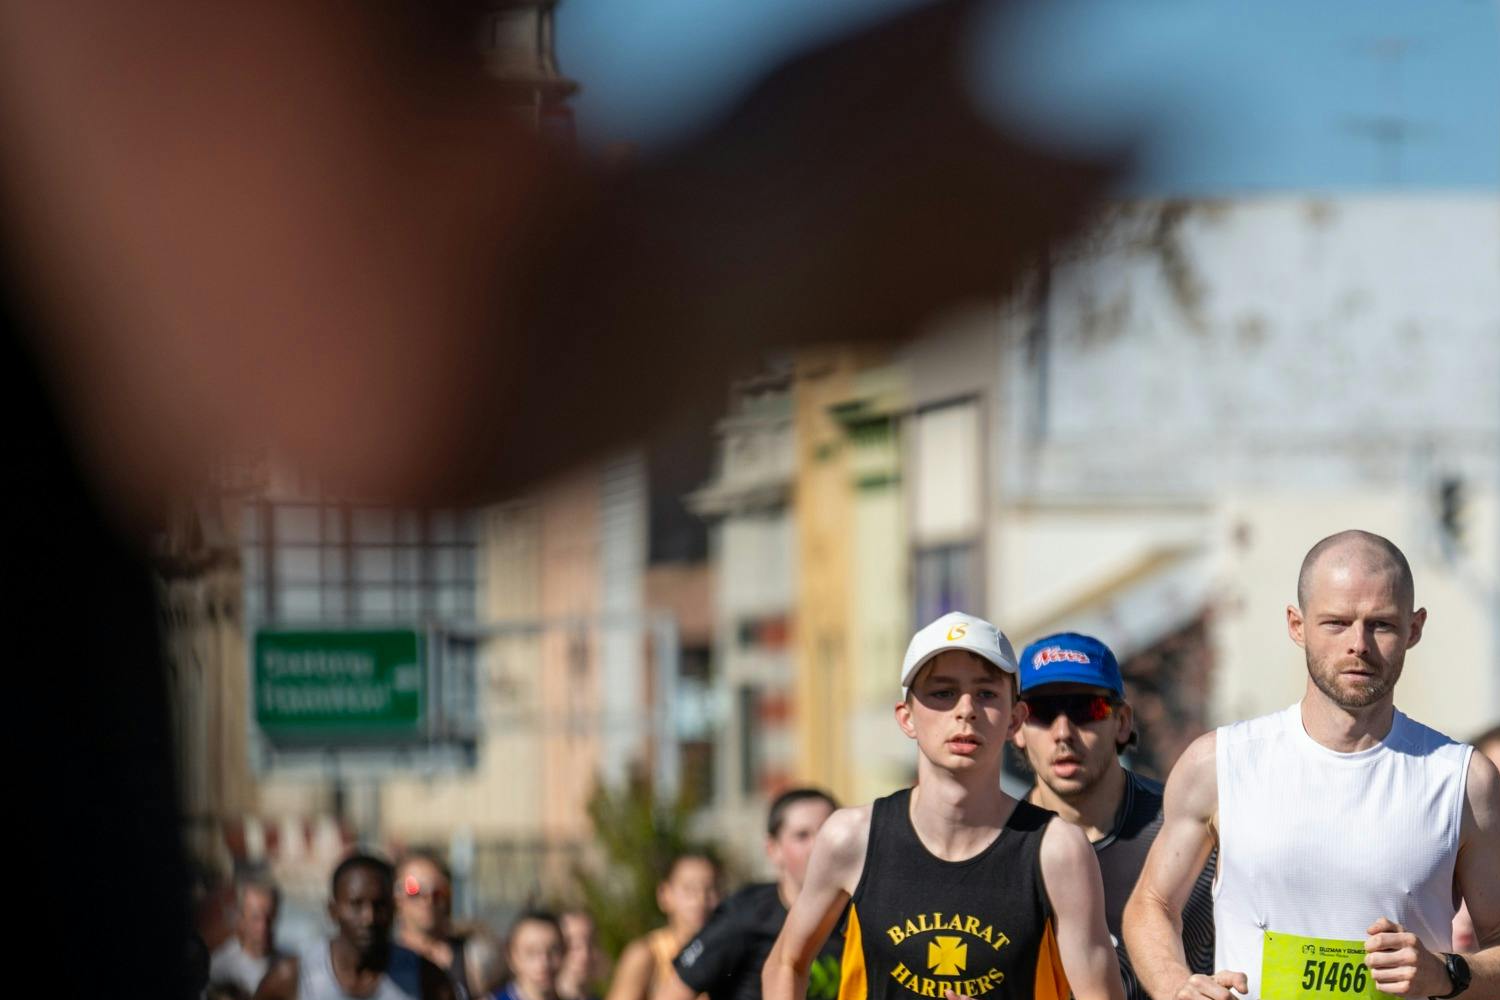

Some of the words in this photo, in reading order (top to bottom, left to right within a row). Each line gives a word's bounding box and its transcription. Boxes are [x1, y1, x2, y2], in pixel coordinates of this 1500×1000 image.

[886, 912, 1010, 951] BALLARAT
[890, 961, 1005, 998] HARRIERS
[1302, 959, 1368, 993] 51466
